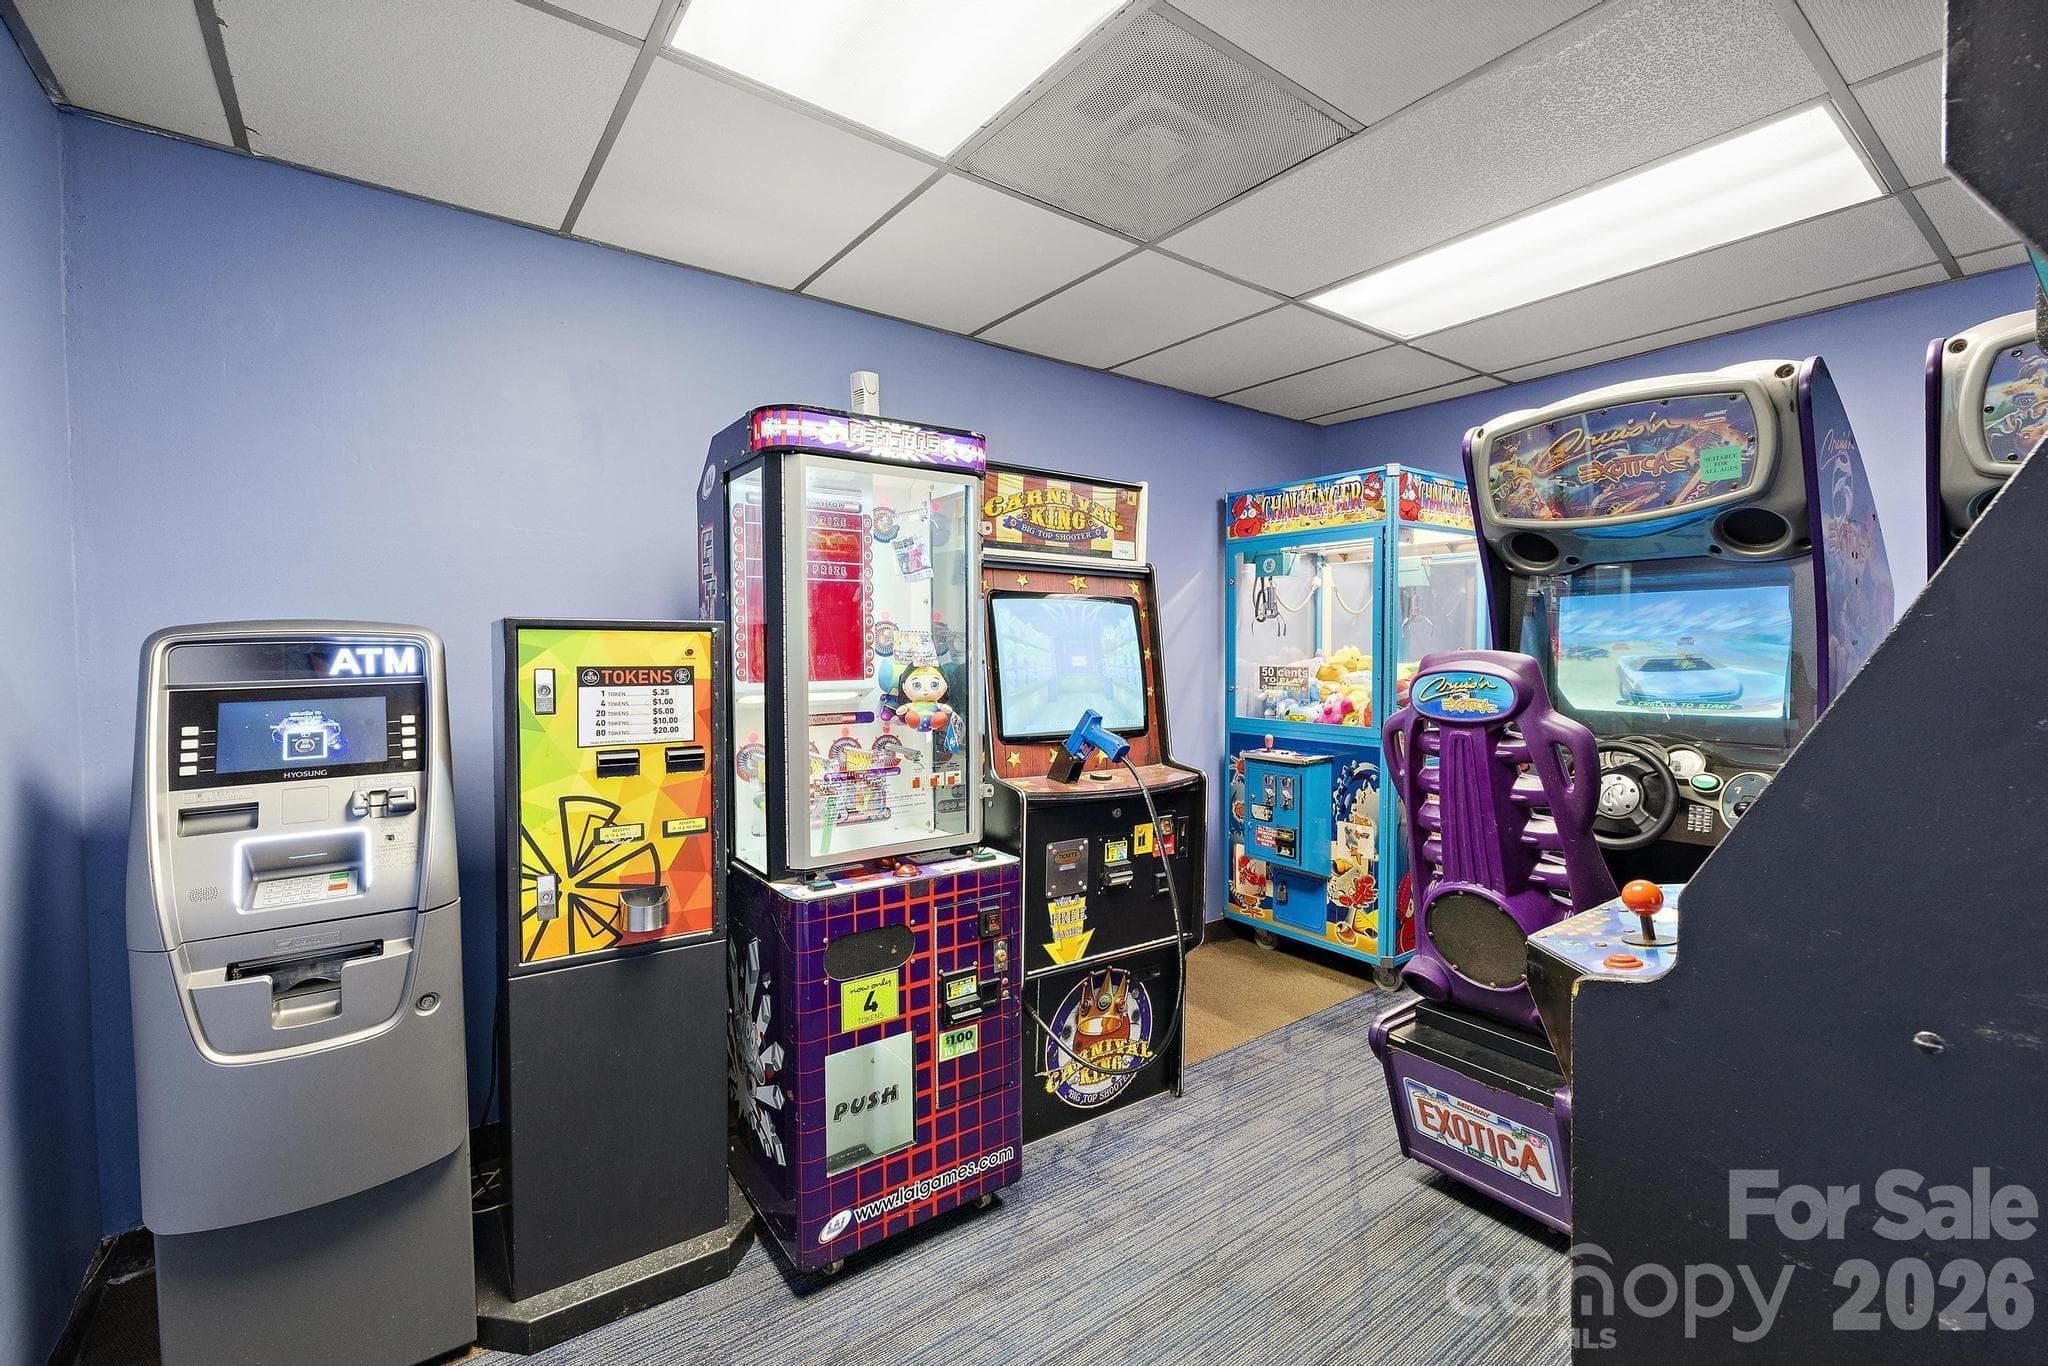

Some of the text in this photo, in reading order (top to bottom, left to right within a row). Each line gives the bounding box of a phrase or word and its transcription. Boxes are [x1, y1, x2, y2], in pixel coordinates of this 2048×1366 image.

[1704, 453, 1738, 462] SUITABLE
[1578, 452, 1686, 484] EXOTICA
[984, 488, 1123, 531] CARNIVAL
[811, 515, 847, 527] PRIZE
[1030, 506, 1086, 531] KING
[1021, 525, 1092, 541] BIG TOP SHOOTER
[812, 565, 847, 576] PRIZE
[329, 647, 416, 676] ATM
[601, 669, 673, 685] TOKENS
[1262, 667, 1308, 678] 50 cents
[652, 688, 670, 696] $.25
[1419, 676, 1497, 702] Cruis'n
[652, 698, 674, 706] $1.00
[652, 707, 675, 715] $5.00
[596, 719, 606, 727] 40
[652, 716, 678, 725] $10.00
[596, 729, 606, 737] 80
[652, 725, 679, 735] $20.00
[283, 769, 328, 779] HYOSUNG
[1050, 906, 1087, 929] FREE
[850, 978, 892, 994] now only
[863, 990, 879, 1012] 4
[857, 1012, 884, 1024] TOKENS
[945, 1030, 973, 1046] $1.00
[955, 1040, 974, 1053] PLAY
[833, 1083, 899, 1122] PUSH
[1069, 1089, 1081, 1102] BIG
[1082, 1094, 1097, 1105] TOP
[1456, 1101, 1490, 1119] MIDWAY
[1417, 1099, 1547, 1181] EXOTICA
[853, 1145, 1014, 1223] www.laigames.com
